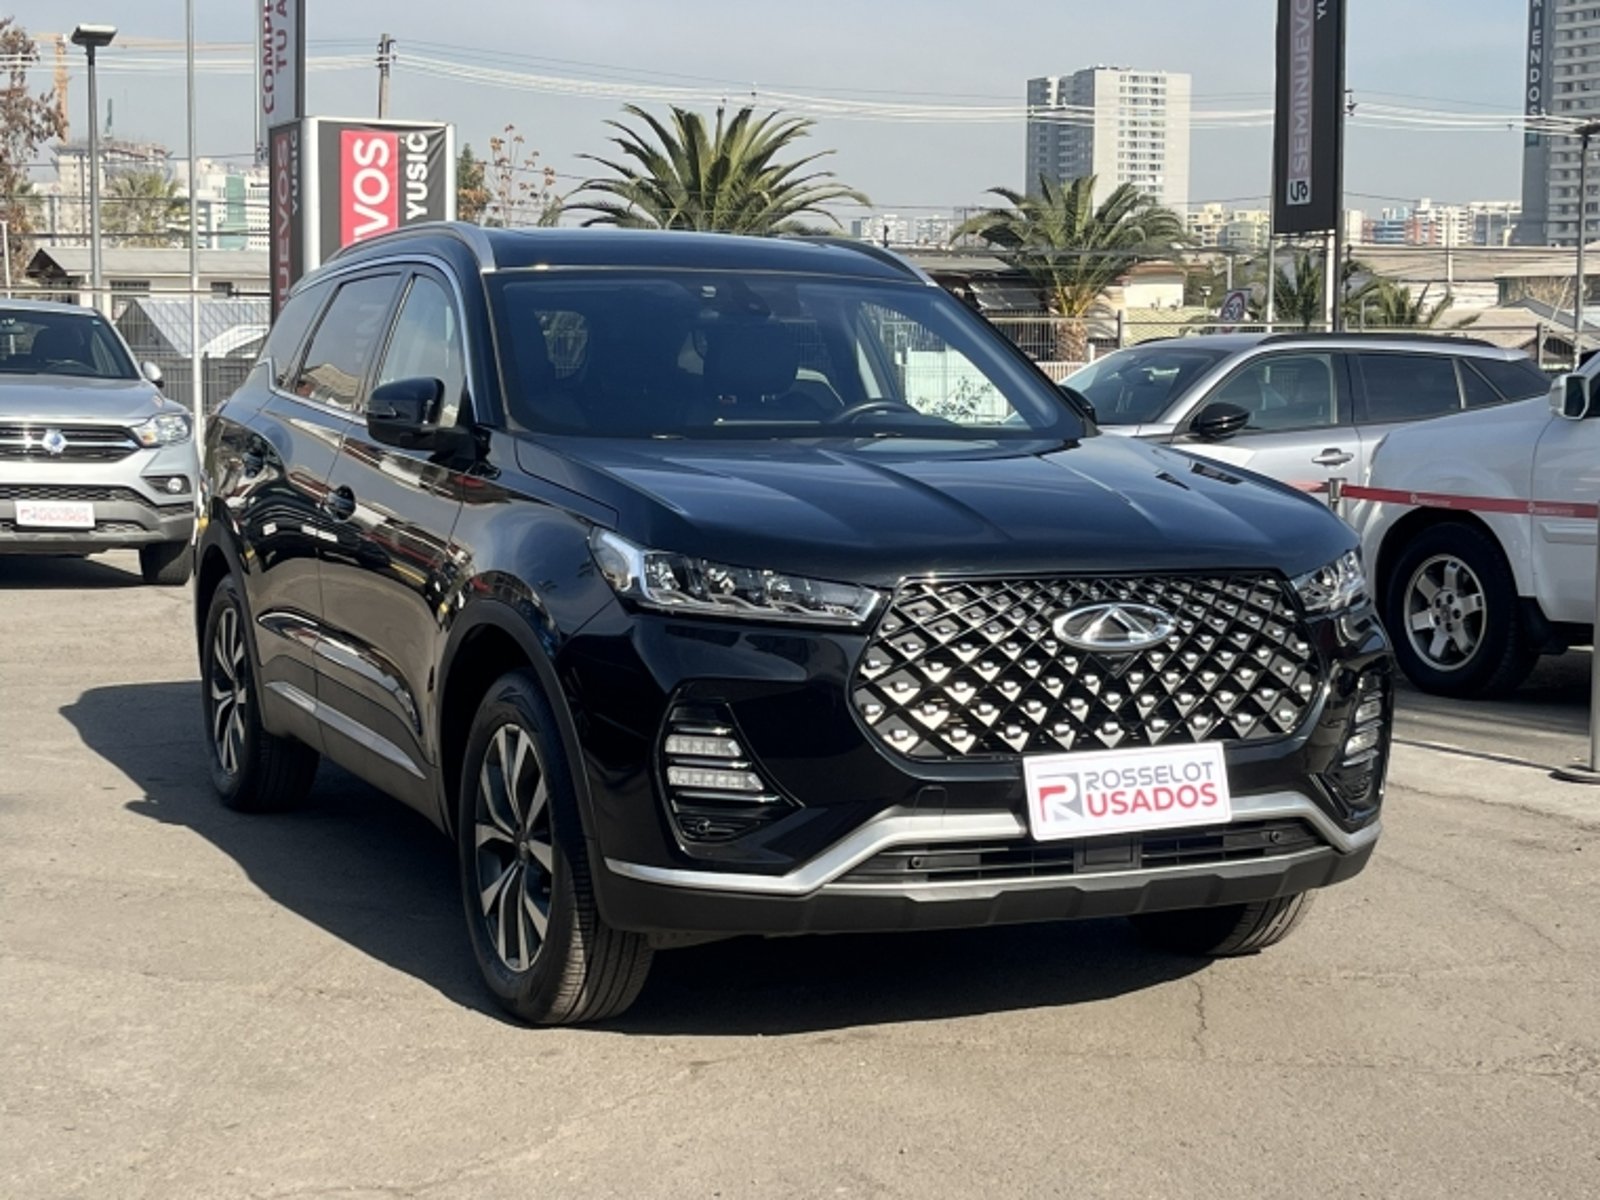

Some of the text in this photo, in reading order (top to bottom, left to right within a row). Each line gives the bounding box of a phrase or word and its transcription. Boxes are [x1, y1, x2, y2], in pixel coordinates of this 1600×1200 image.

[275, 29, 287, 75] TU
[400, 132, 428, 220] YUSIĆ
[1084, 761, 1214, 791] ROSSELOT
[1087, 782, 1218, 817] USADOS
